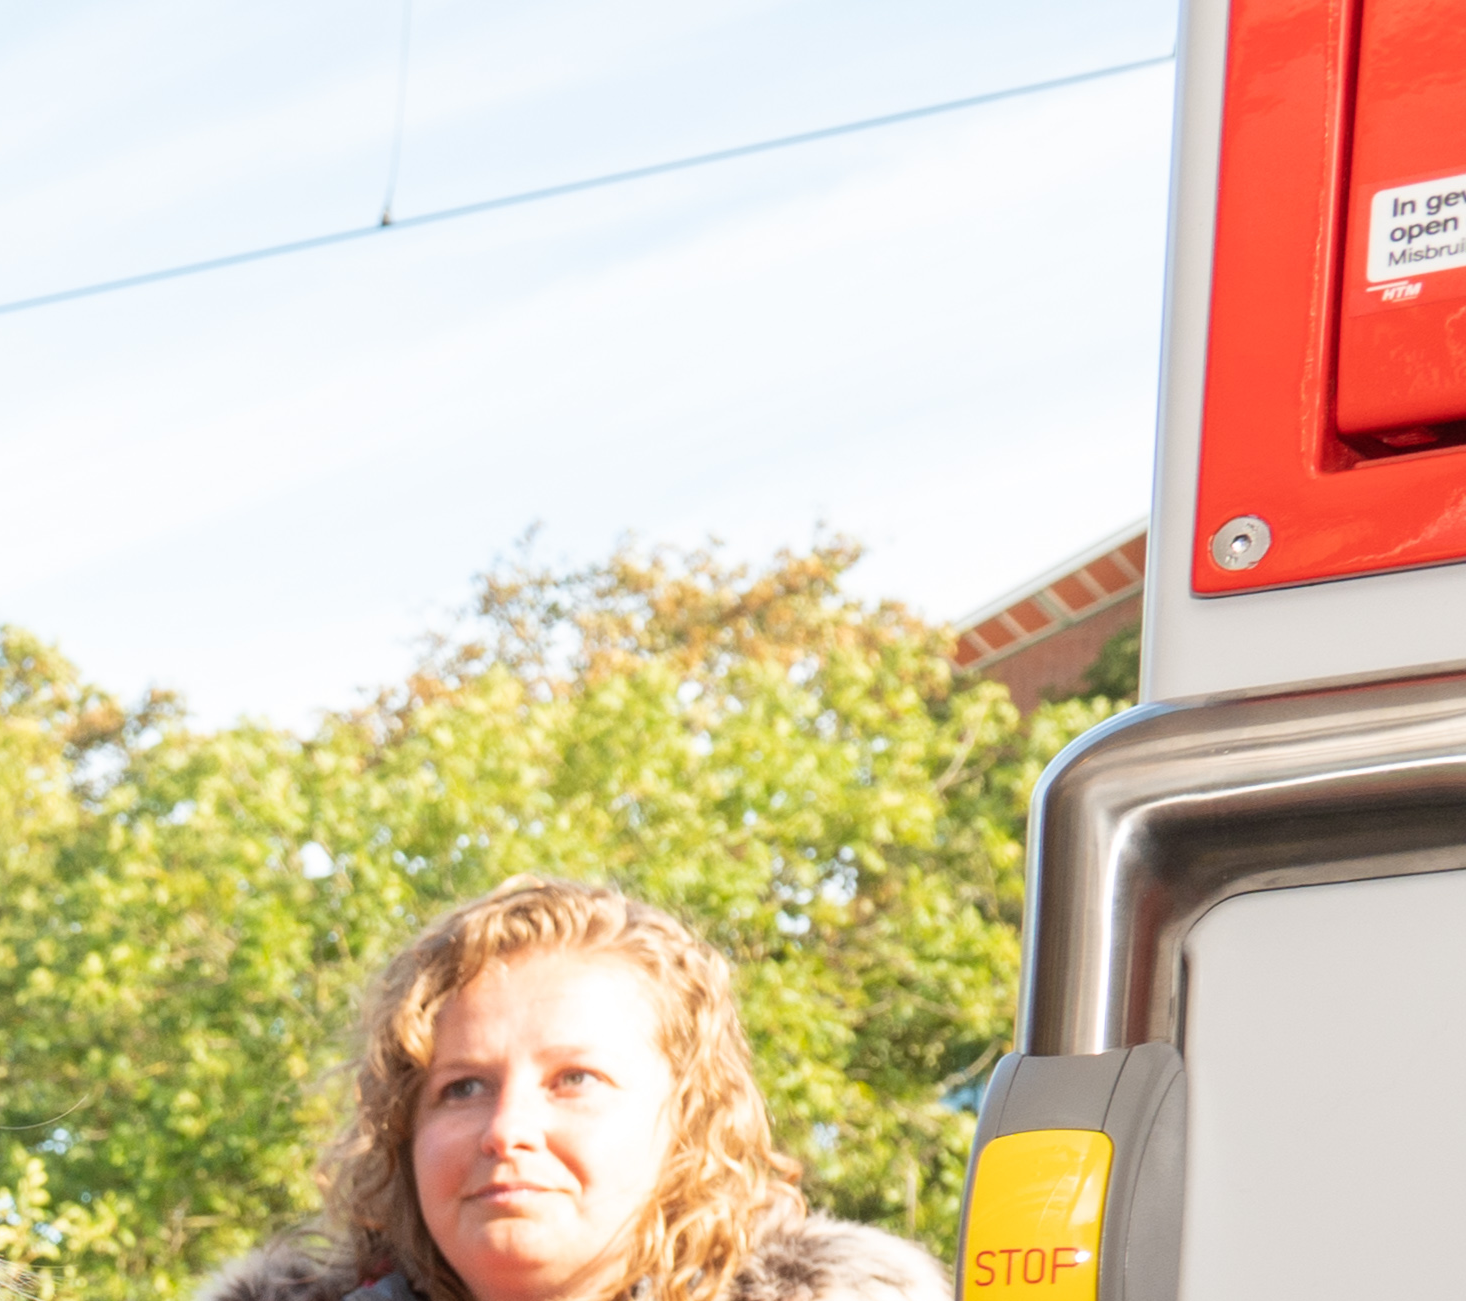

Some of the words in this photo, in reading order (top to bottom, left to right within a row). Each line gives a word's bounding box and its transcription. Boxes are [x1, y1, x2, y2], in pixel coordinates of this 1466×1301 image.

[1391, 197, 1416, 218] In
[1389, 216, 1459, 245] open
[1381, 281, 1422, 302] HTM
[974, 1246, 1084, 1287] STOP
